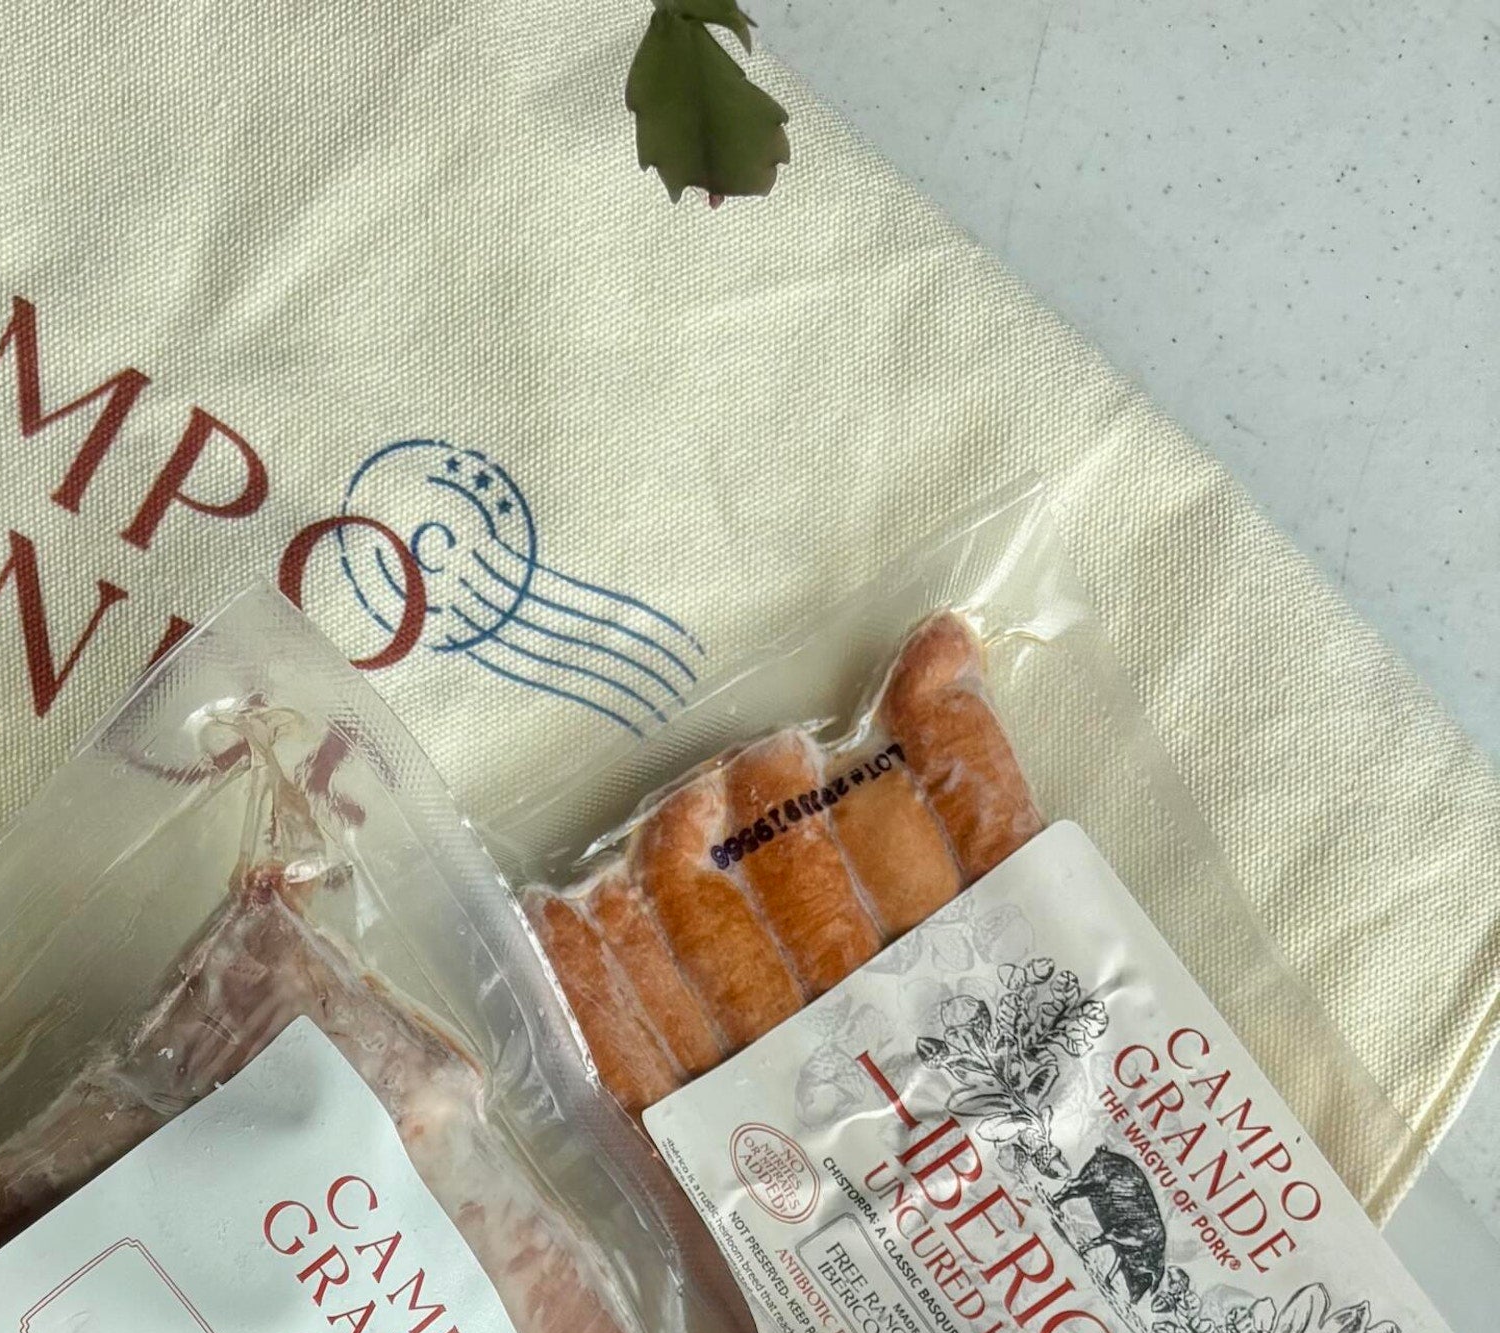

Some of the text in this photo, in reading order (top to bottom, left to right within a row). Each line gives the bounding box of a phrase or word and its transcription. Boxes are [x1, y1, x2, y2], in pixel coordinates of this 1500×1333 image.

[1098, 1084, 1130, 1124] THE
[1122, 1120, 1178, 1188] WAGYU
[1172, 1189, 1198, 1213] OF
[1113, 1044, 1296, 1273] GRANDE
[1166, 1027, 1321, 1221] CAMPO
[727, 1210, 750, 1236] NOT
[786, 1297, 810, 1325] KEEP
[774, 1248, 838, 1327] ANTIBIOTIC
[825, 1241, 868, 1293] FREE
[863, 1161, 986, 1320] UNCURED
[874, 1226, 887, 1239] A
[882, 1238, 922, 1289] CLASSIC
